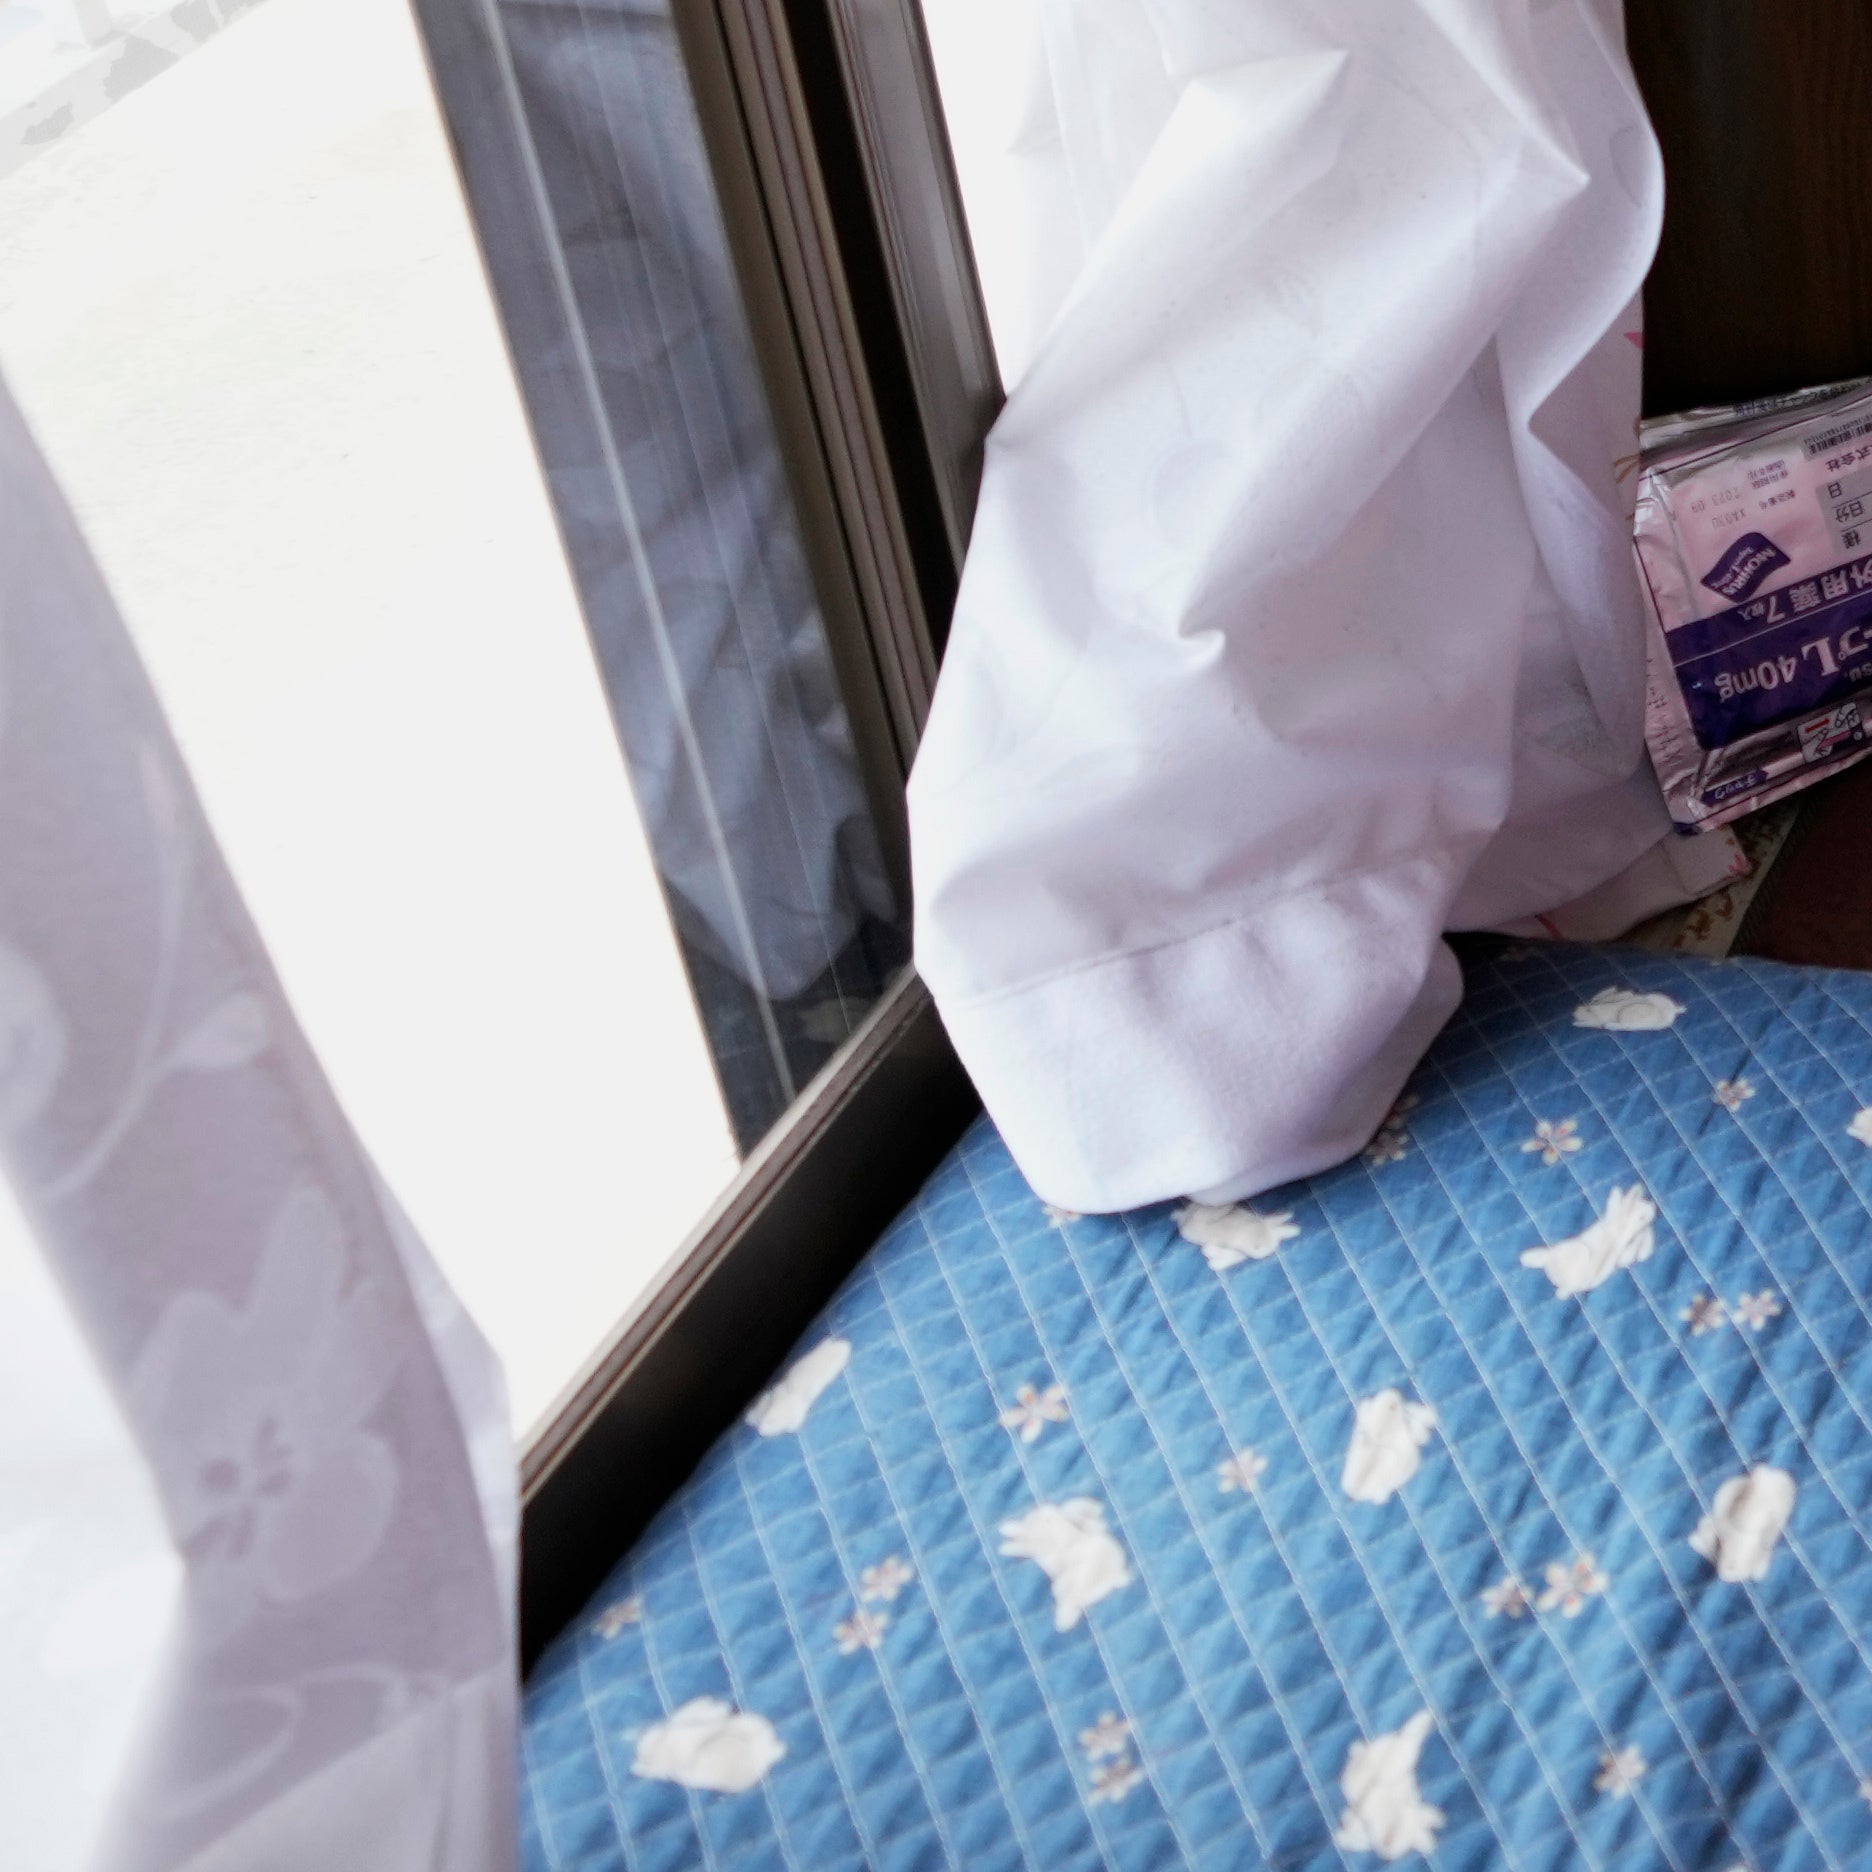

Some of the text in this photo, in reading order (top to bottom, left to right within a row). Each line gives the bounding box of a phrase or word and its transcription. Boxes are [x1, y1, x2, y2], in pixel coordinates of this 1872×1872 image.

[1826, 481, 1842, 499] 日
[1832, 499, 1864, 523] 日分
[1839, 528, 1861, 550] 様
[1712, 652, 1802, 704] 40mg
